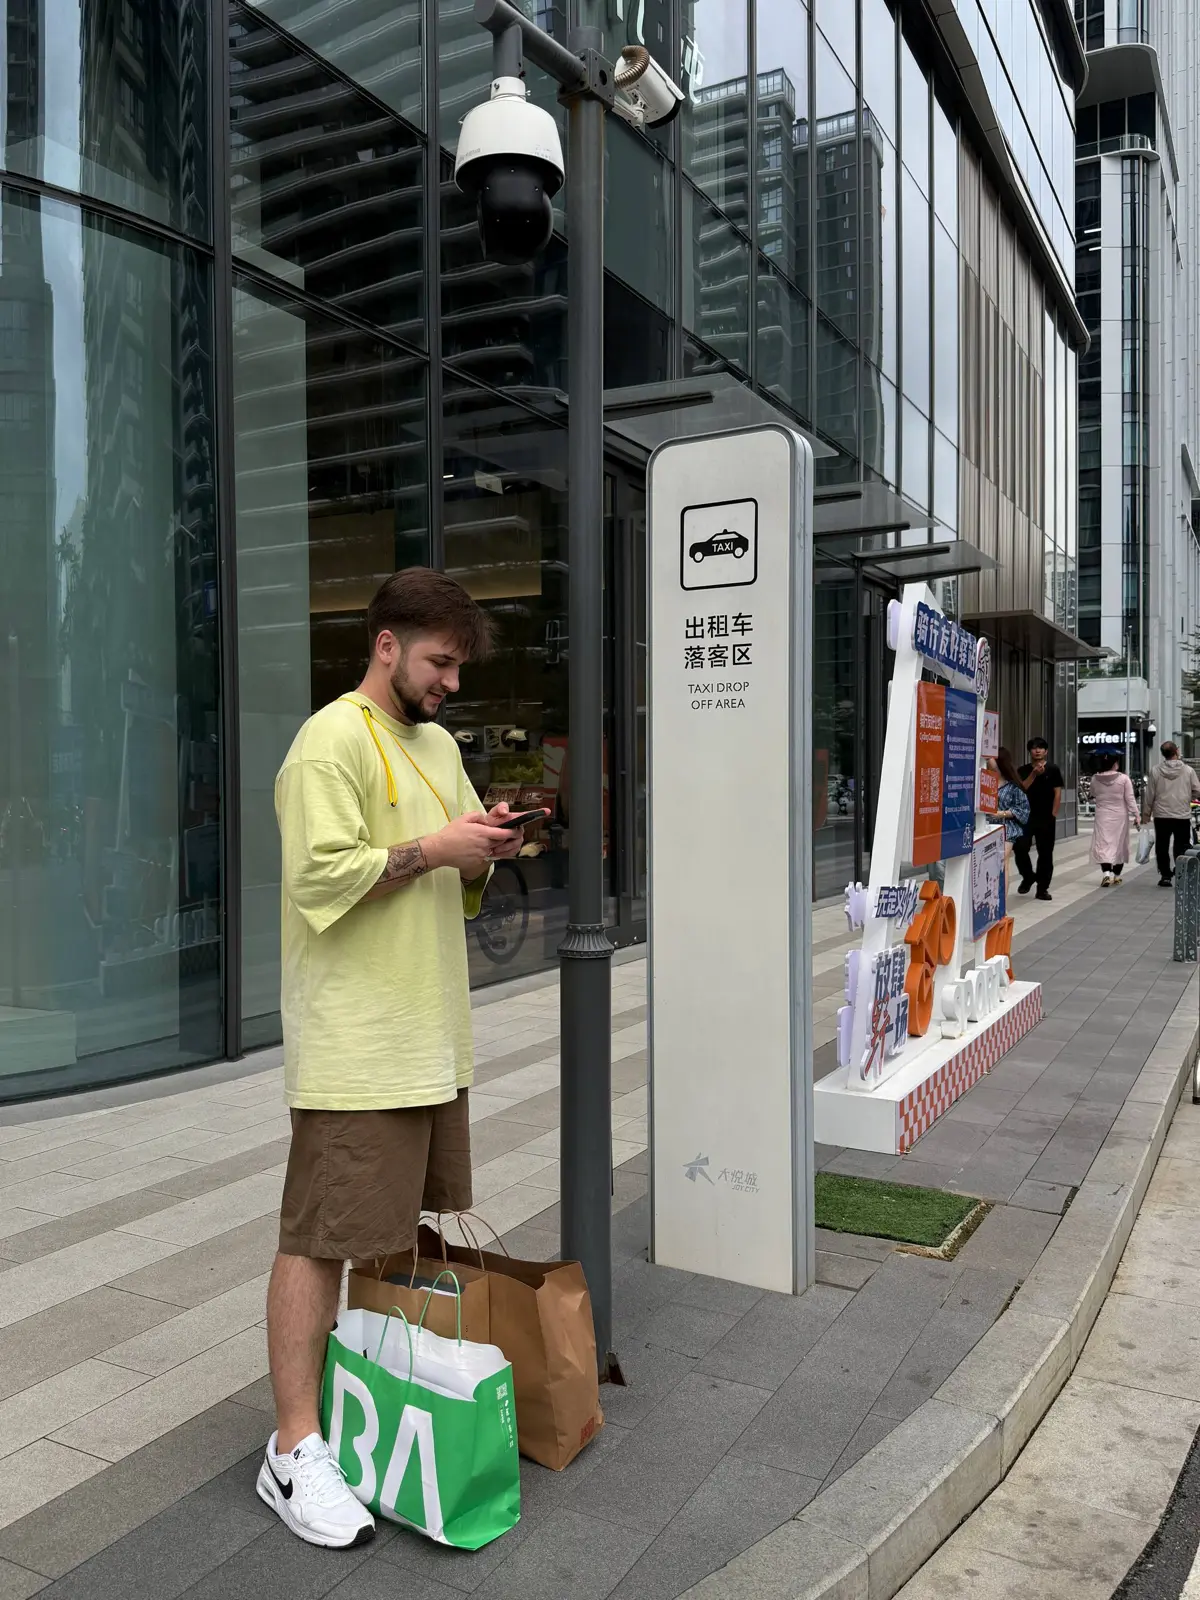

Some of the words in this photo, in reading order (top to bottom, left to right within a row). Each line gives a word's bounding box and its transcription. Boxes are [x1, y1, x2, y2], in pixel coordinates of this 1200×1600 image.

[712, 542, 734, 552] TAXI
[685, 612, 753, 639] 出租车
[684, 643, 753, 669] 落客区
[688, 683, 714, 694] TAXI
[716, 681, 750, 693] DROP
[691, 699, 713, 710] OFF
[715, 698, 746, 709] AREA
[1082, 732, 1120, 744] coffee
[717, 1167, 758, 1187] 大悦城
[731, 1184, 745, 1192] JOY
[745, 1186, 760, 1194] CITY
